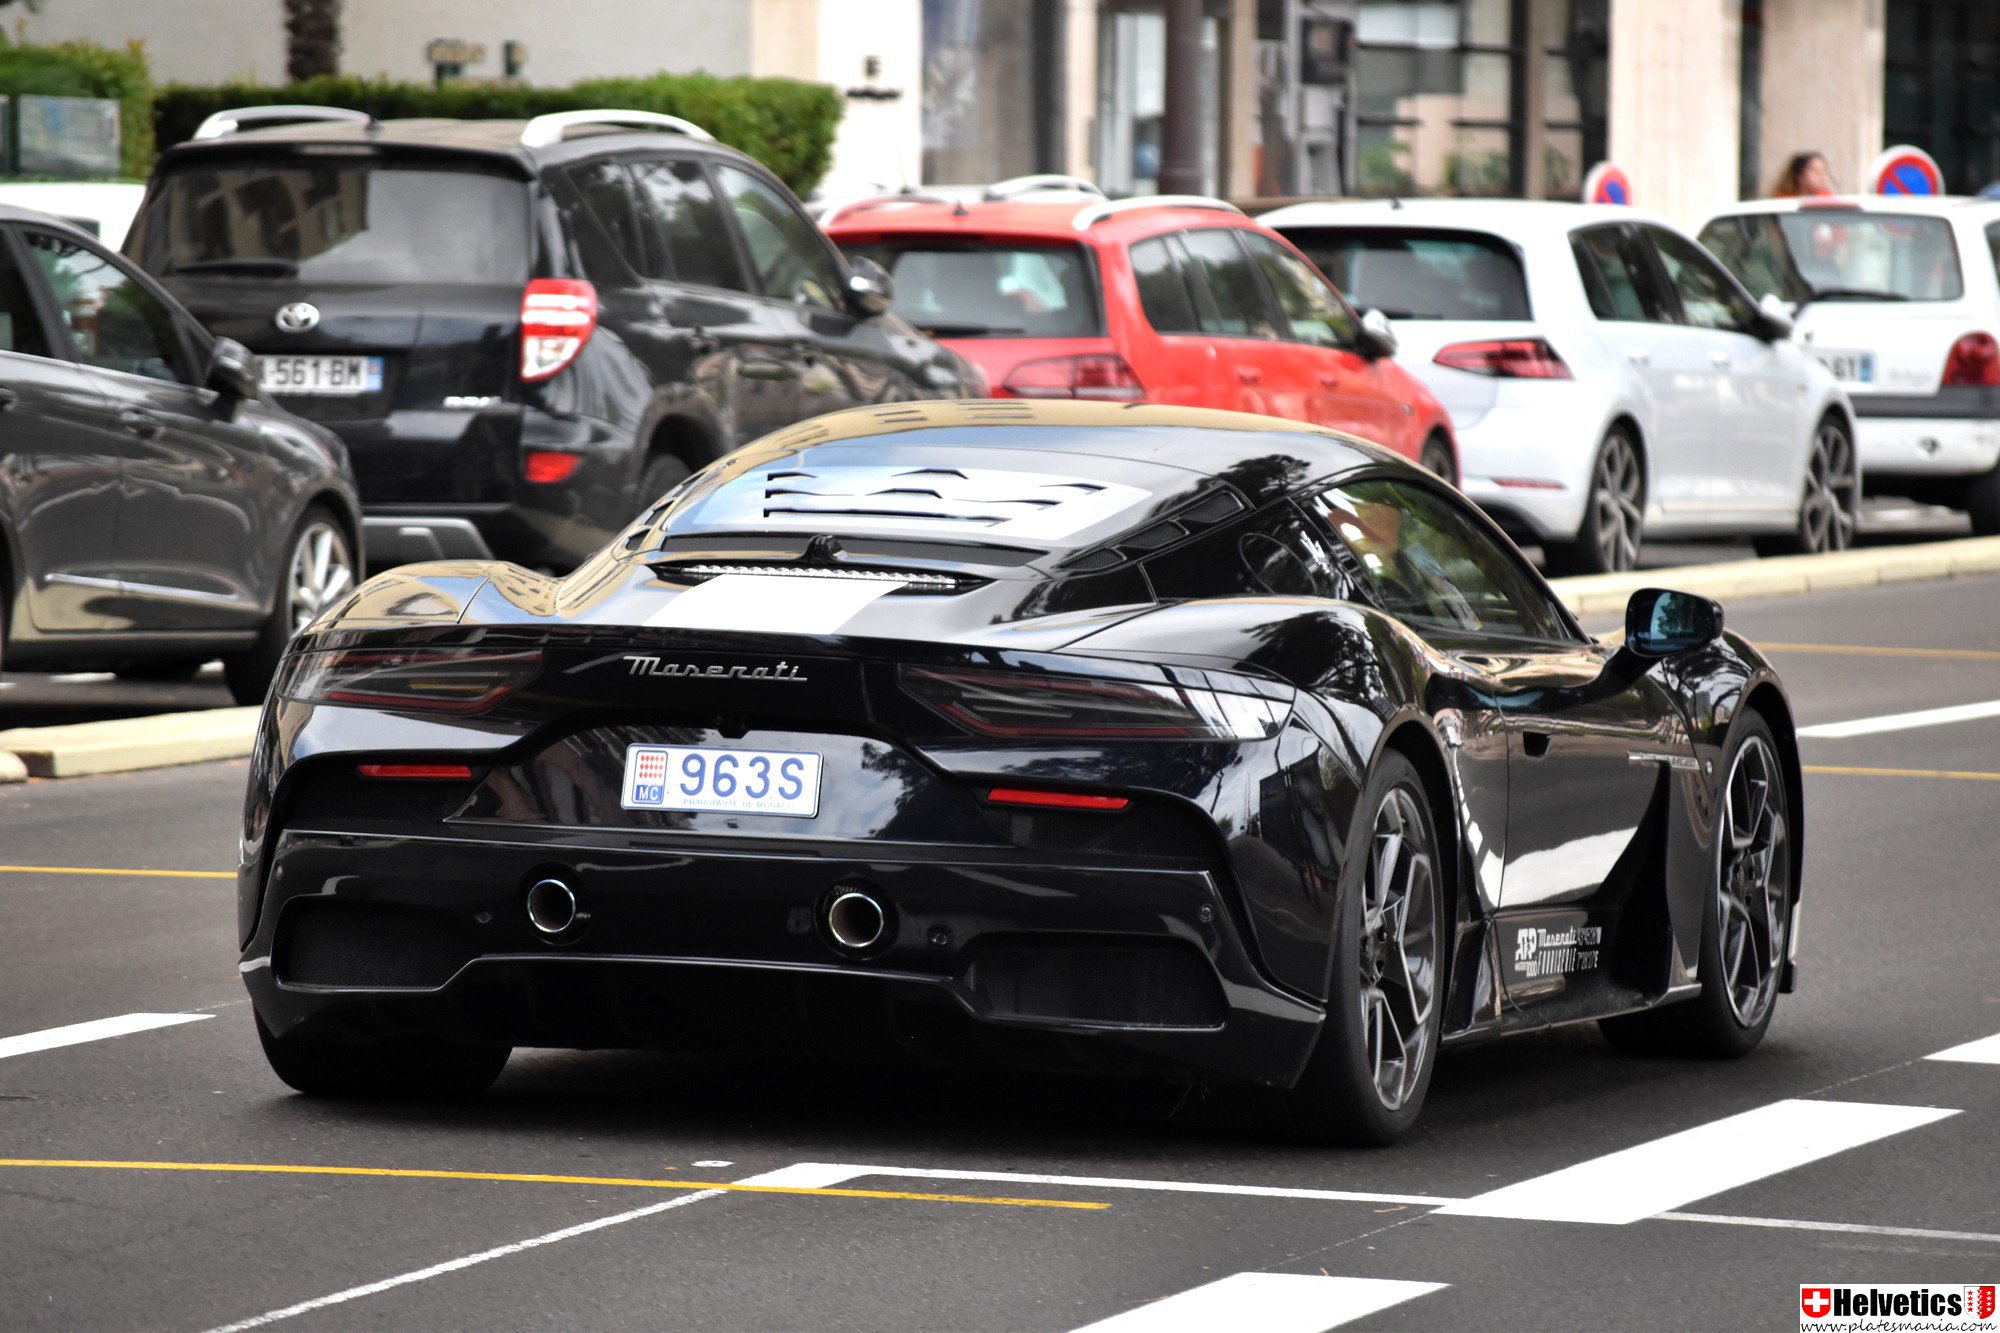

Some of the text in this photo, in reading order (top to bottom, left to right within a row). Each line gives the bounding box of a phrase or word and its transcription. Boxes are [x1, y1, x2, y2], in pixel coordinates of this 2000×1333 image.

[623, 656, 807, 681] Maserati
[680, 753, 804, 800] 963S
[638, 786, 659, 800] MC
[1537, 925, 1577, 947] Maserati
